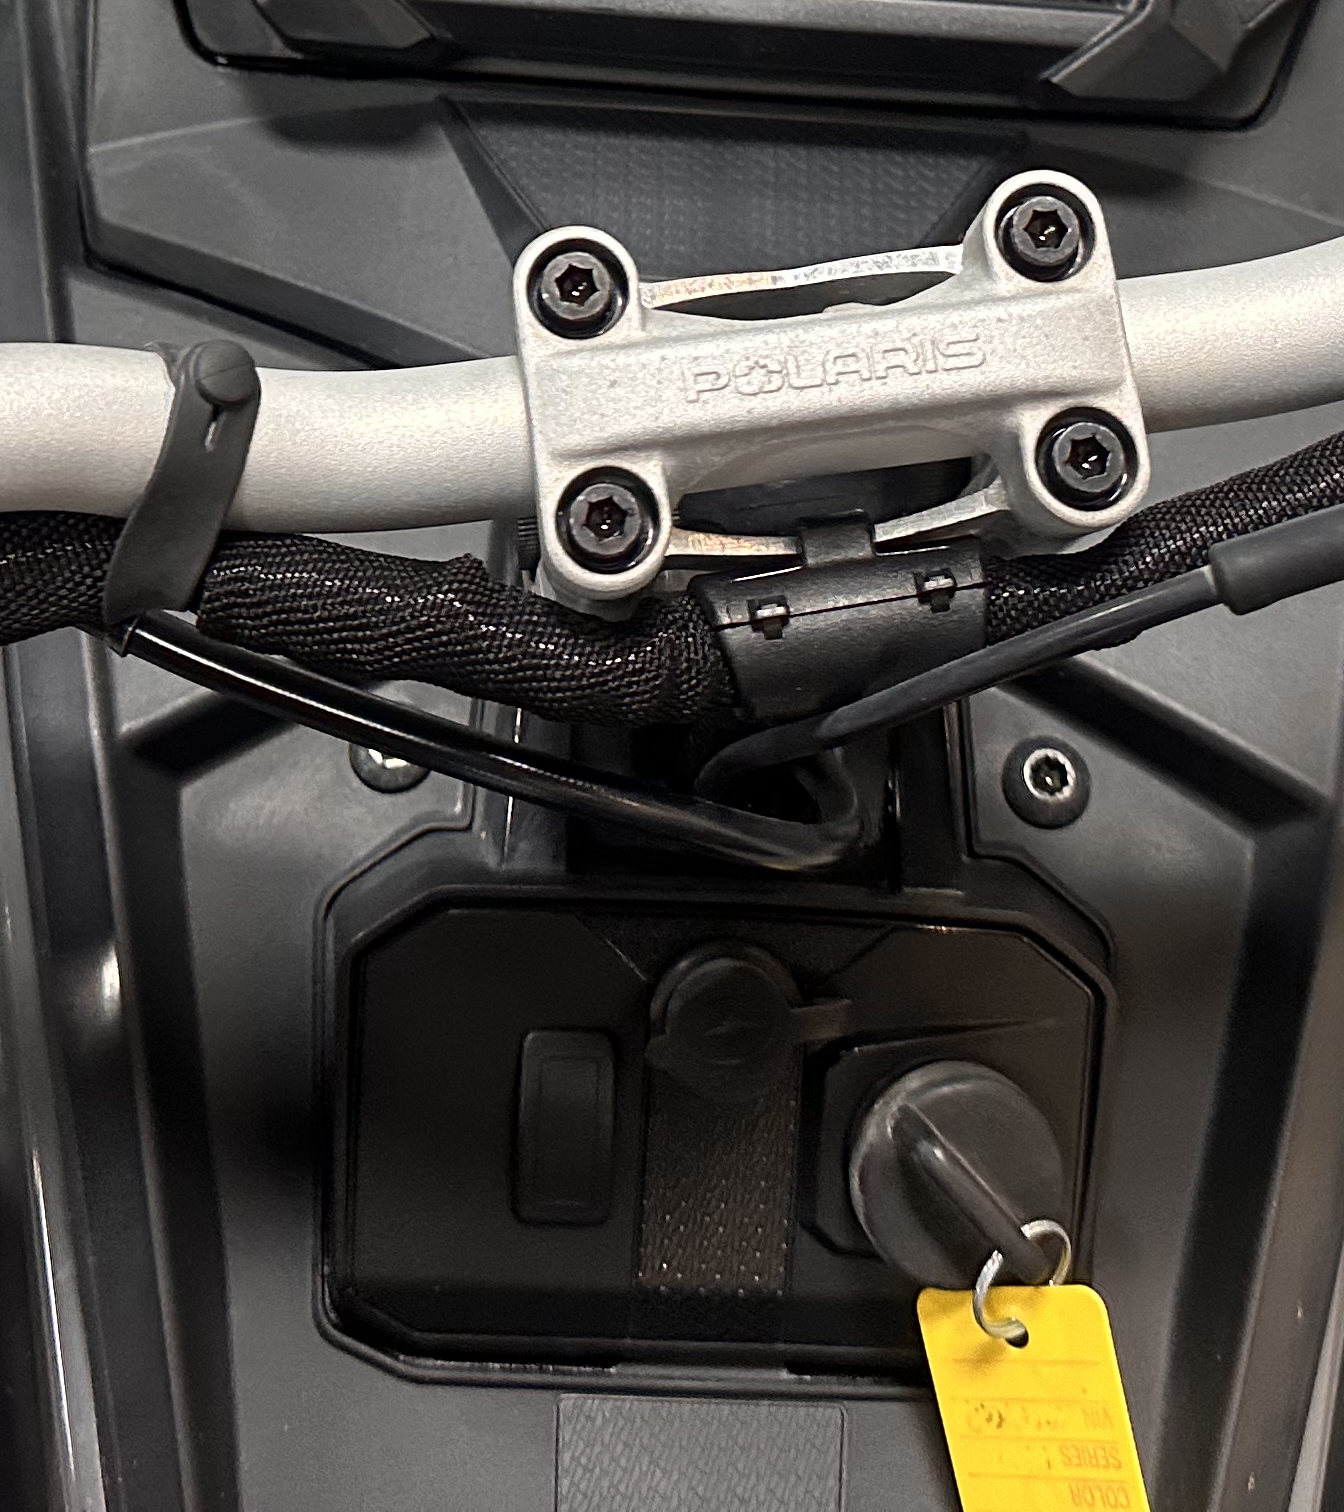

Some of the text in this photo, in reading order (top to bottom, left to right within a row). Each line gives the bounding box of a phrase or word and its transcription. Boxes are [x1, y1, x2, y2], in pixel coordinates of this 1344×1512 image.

[682, 333, 987, 403] POLARIS
[1059, 1444, 1123, 1469] SERIES
[1067, 1484, 1131, 1509] COLOR
